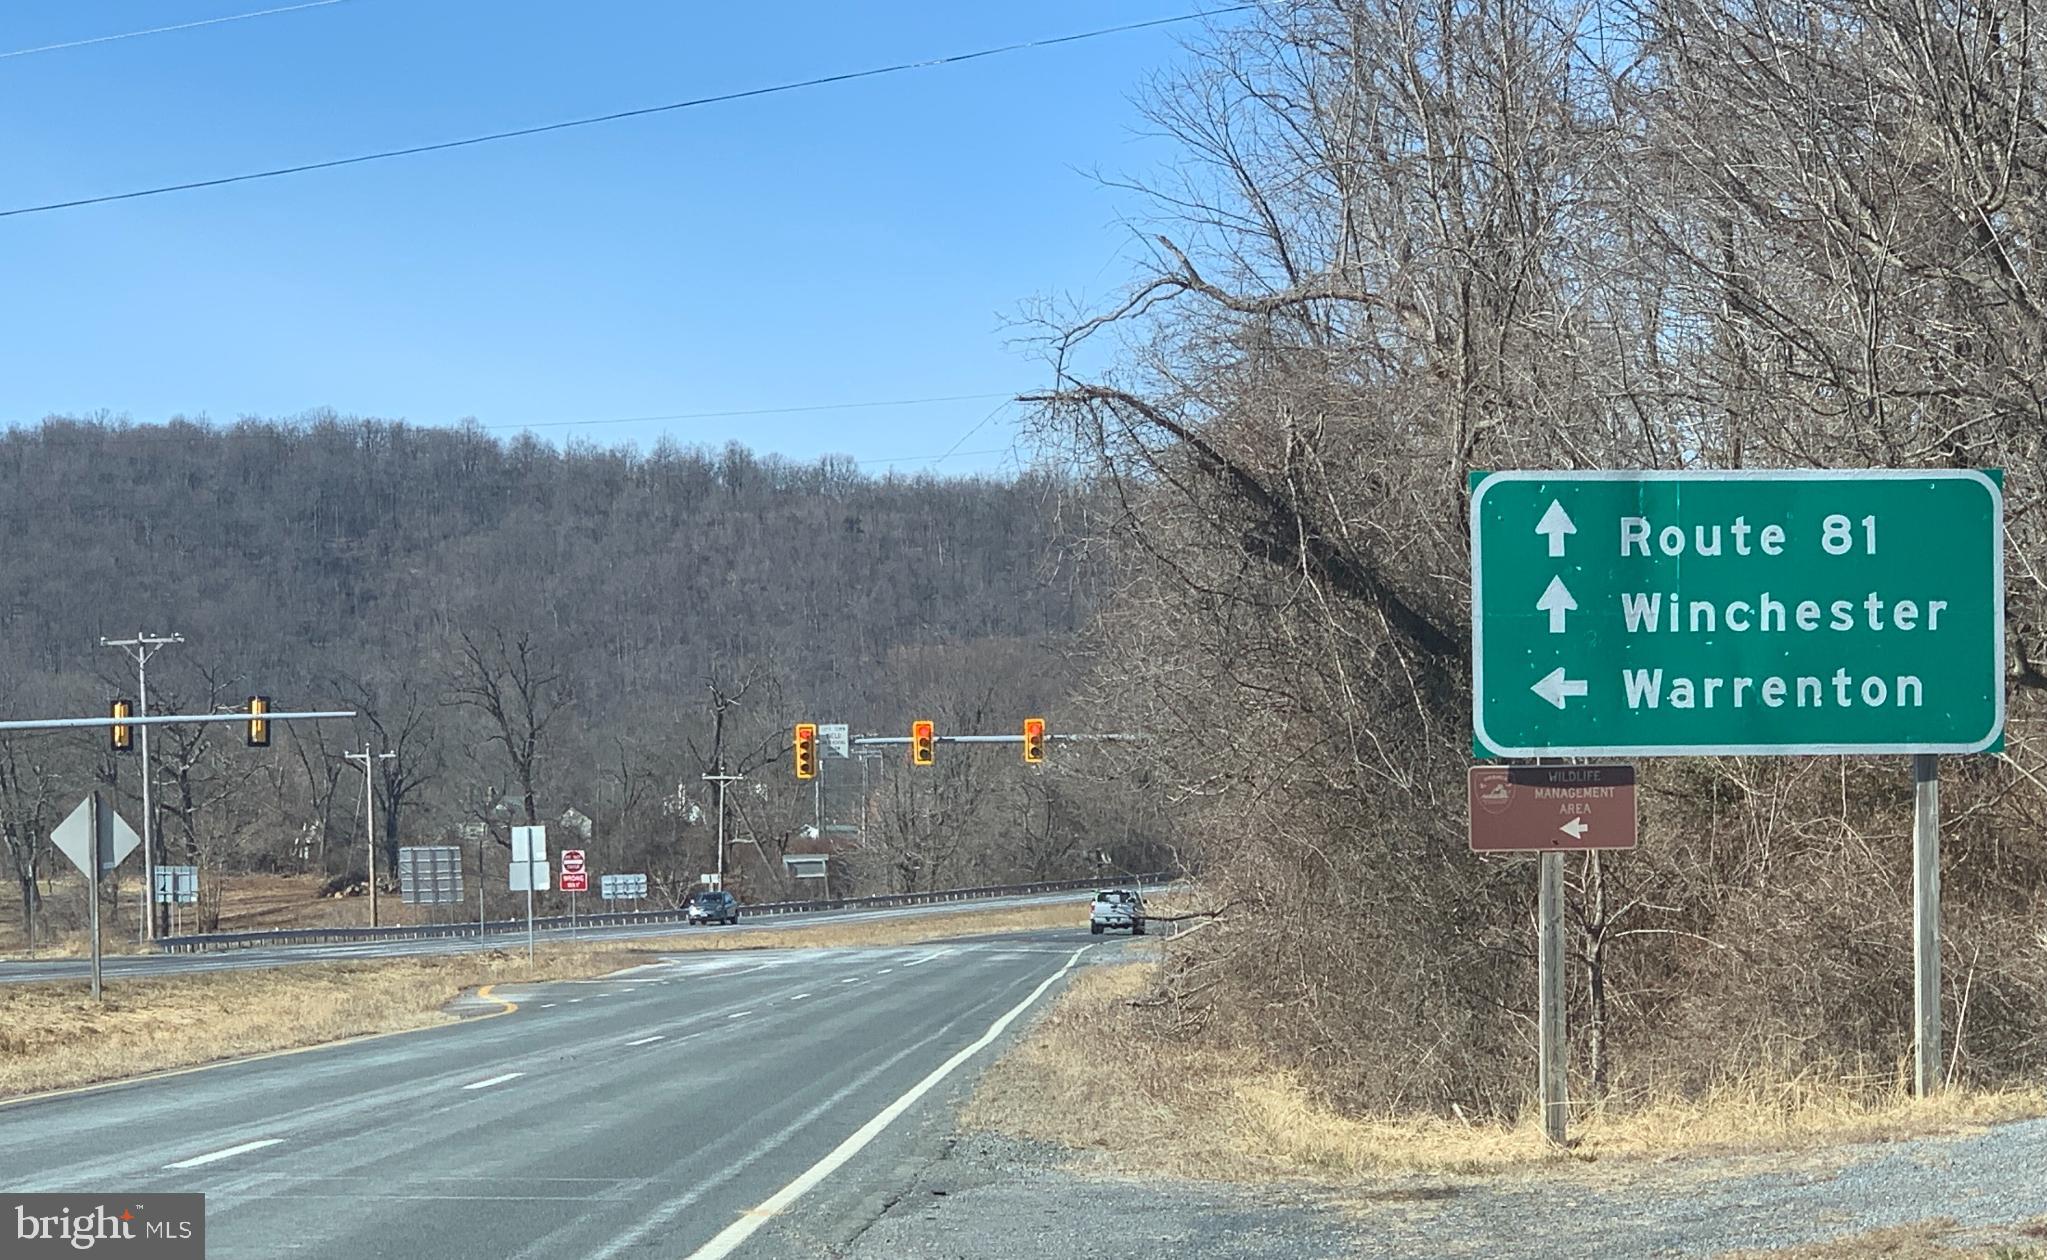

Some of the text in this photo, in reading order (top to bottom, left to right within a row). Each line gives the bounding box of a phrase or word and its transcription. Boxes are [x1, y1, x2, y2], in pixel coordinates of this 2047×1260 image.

[1620, 514, 1877, 557] Route 81
[1621, 591, 1948, 633] Winchester
[1623, 667, 1923, 709] Warrenton
[1548, 770, 1601, 782] WILDLIFE
[1535, 786, 1615, 799] MANAGEMENT
[1559, 803, 1592, 815] AREA
